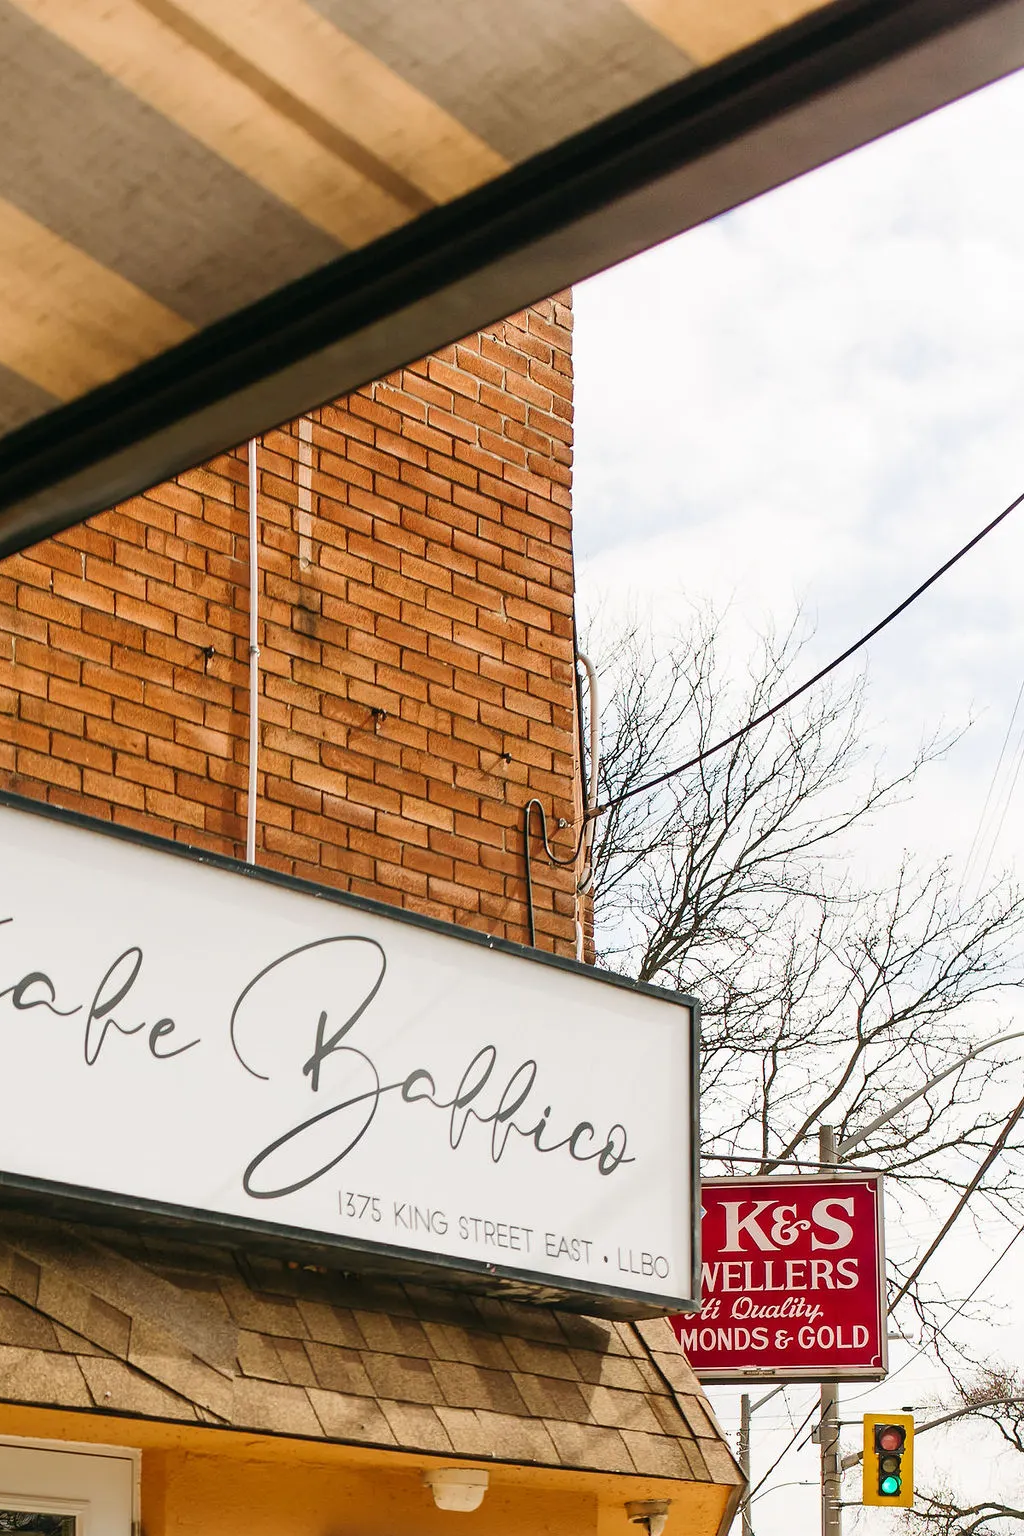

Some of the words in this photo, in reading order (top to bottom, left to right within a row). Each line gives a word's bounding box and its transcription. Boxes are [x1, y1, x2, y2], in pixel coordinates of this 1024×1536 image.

[230, 935, 636, 1199] Baffico
[338, 1190, 382, 1223] 1375
[393, 1201, 448, 1235] KING
[458, 1216, 534, 1253] STREET
[545, 1233, 593, 1264] EAST
[618, 1247, 670, 1279] LLBO
[717, 1197, 855, 1253] K&S
[701, 1258, 859, 1293] WELLERS
[730, 1296, 824, 1324] Quality
[680, 1326, 769, 1352] MONDS
[797, 1324, 870, 1350] GOLD
